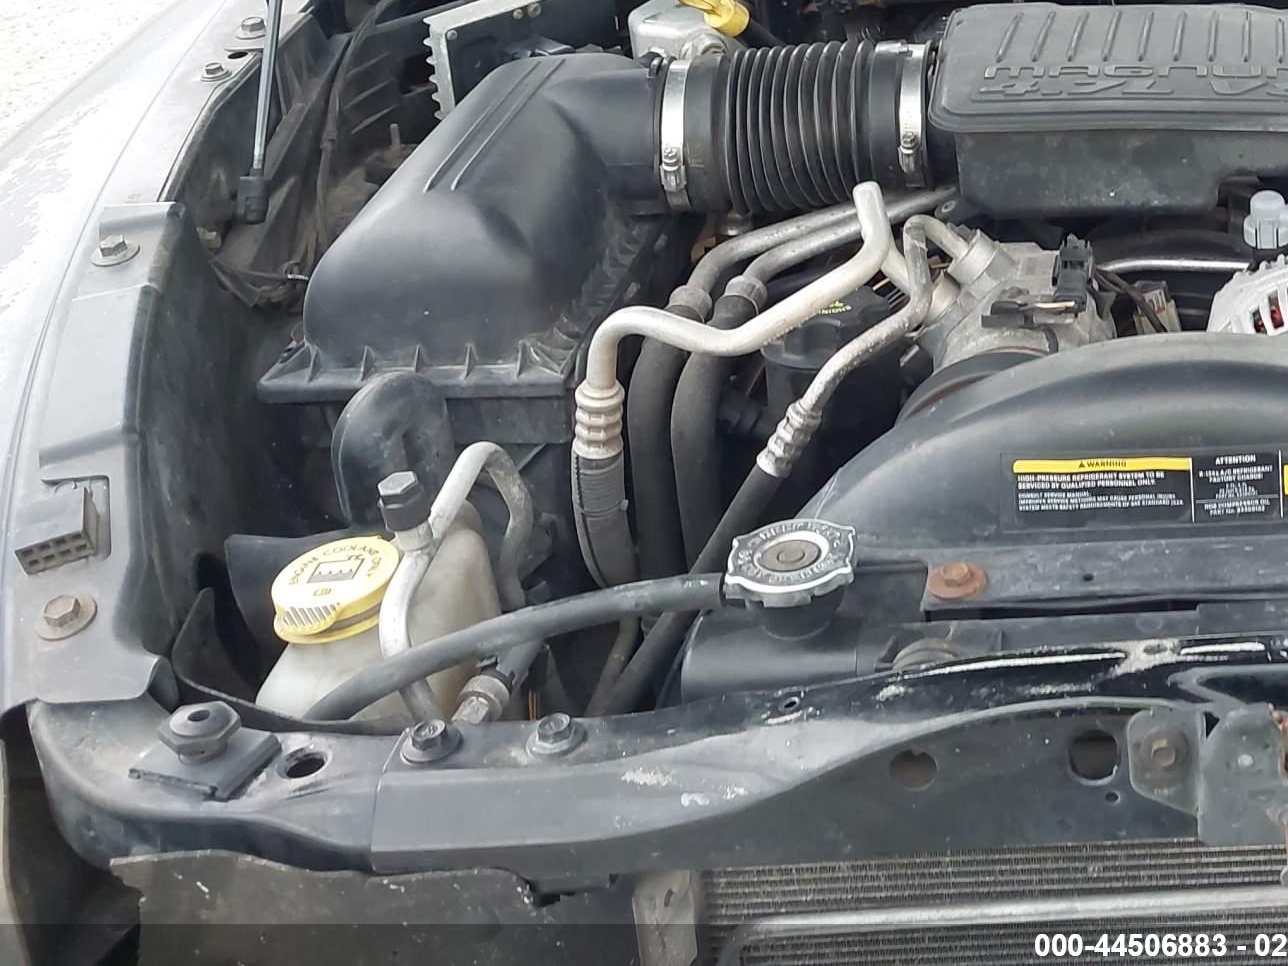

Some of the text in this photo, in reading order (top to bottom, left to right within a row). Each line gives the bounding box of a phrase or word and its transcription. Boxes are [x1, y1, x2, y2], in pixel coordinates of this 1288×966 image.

[978, 80, 1175, 97] 4.7L
[1086, 459, 1127, 468] WARNING
[1215, 454, 1256, 465] ATTENTION
[1018, 470, 1165, 483] HIGH-PRESSURE REFRIGERANT SYSTEM TO BE
[1018, 481, 1050, 490] SERVICED
[1051, 481, 1060, 490] BY
[1061, 480, 1096, 490] QUALIFIED
[1097, 478, 1136, 488] PERSONNEL
[322, 544, 380, 556] COOLANT
